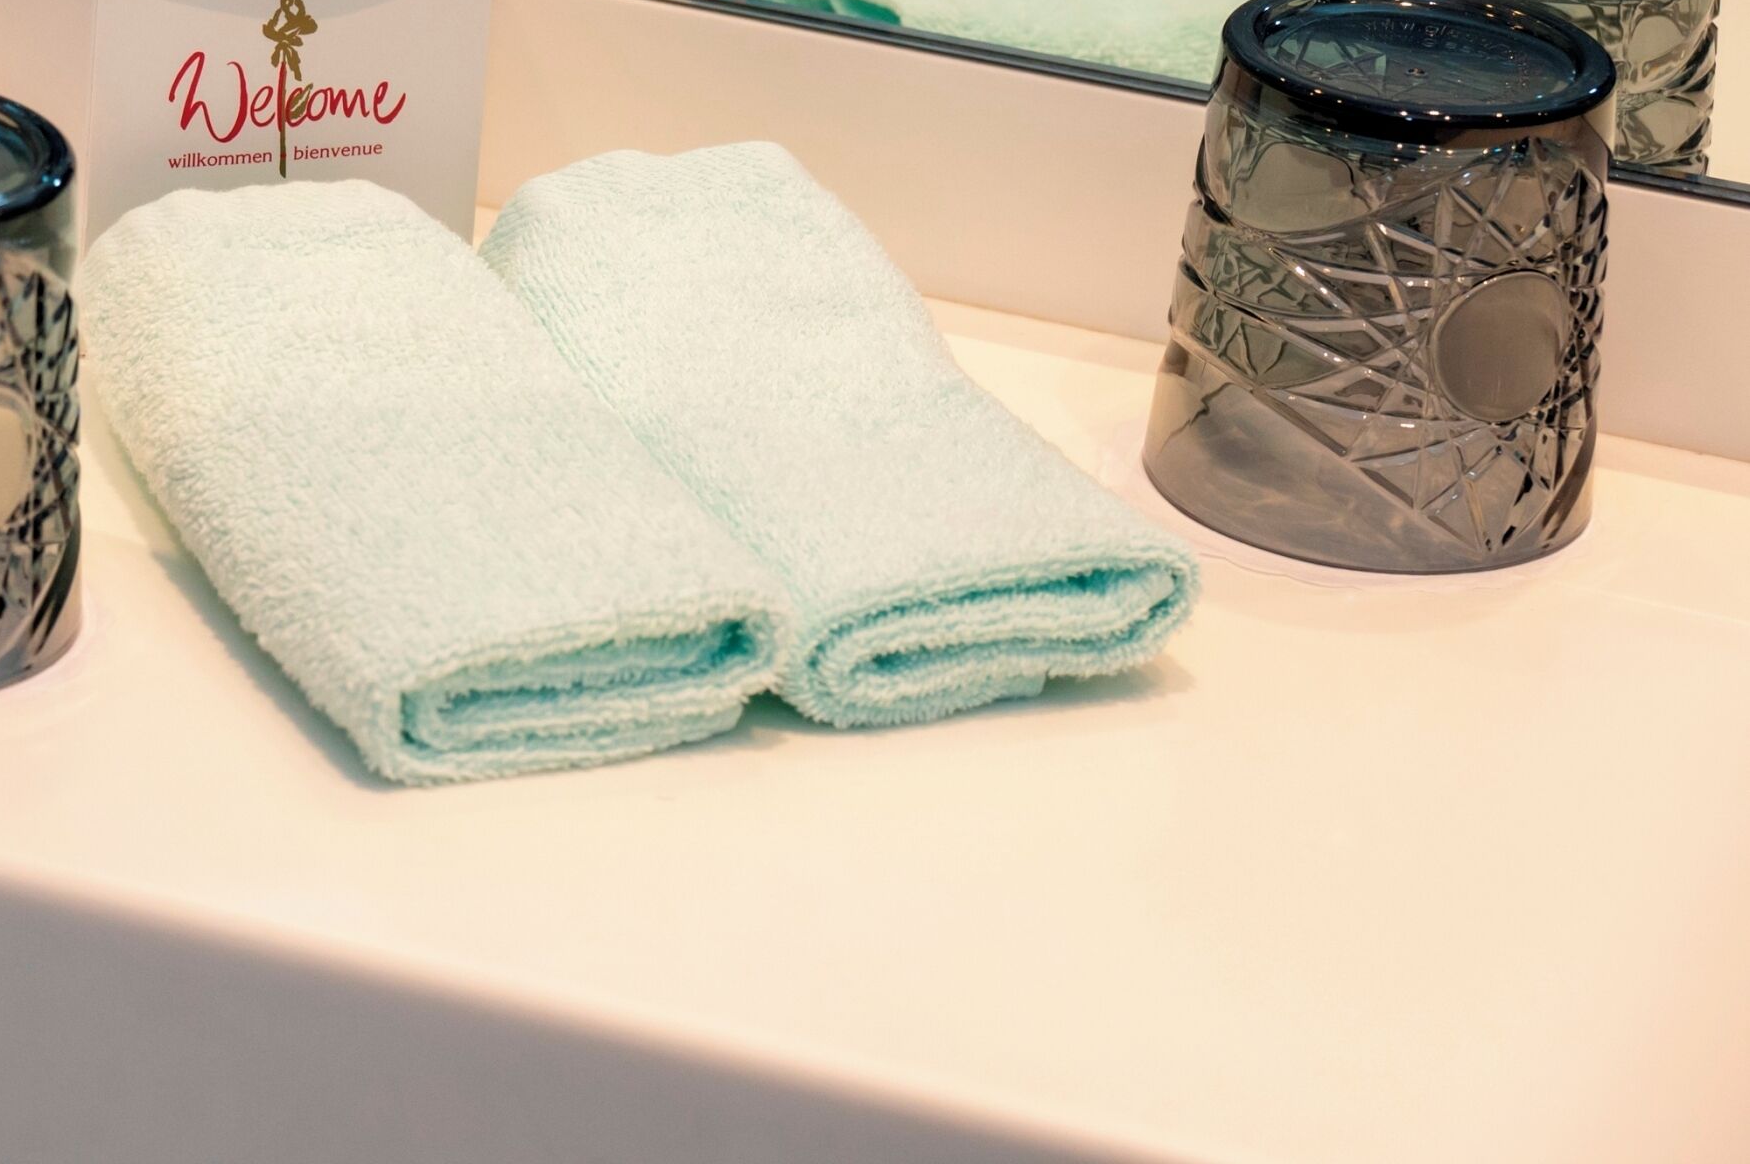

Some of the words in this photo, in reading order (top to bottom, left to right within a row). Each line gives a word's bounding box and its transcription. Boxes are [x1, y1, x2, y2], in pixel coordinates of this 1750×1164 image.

[168, 51, 406, 143] Welcome
[168, 151, 273, 169] willkommen
[293, 142, 383, 161] bienvenue
